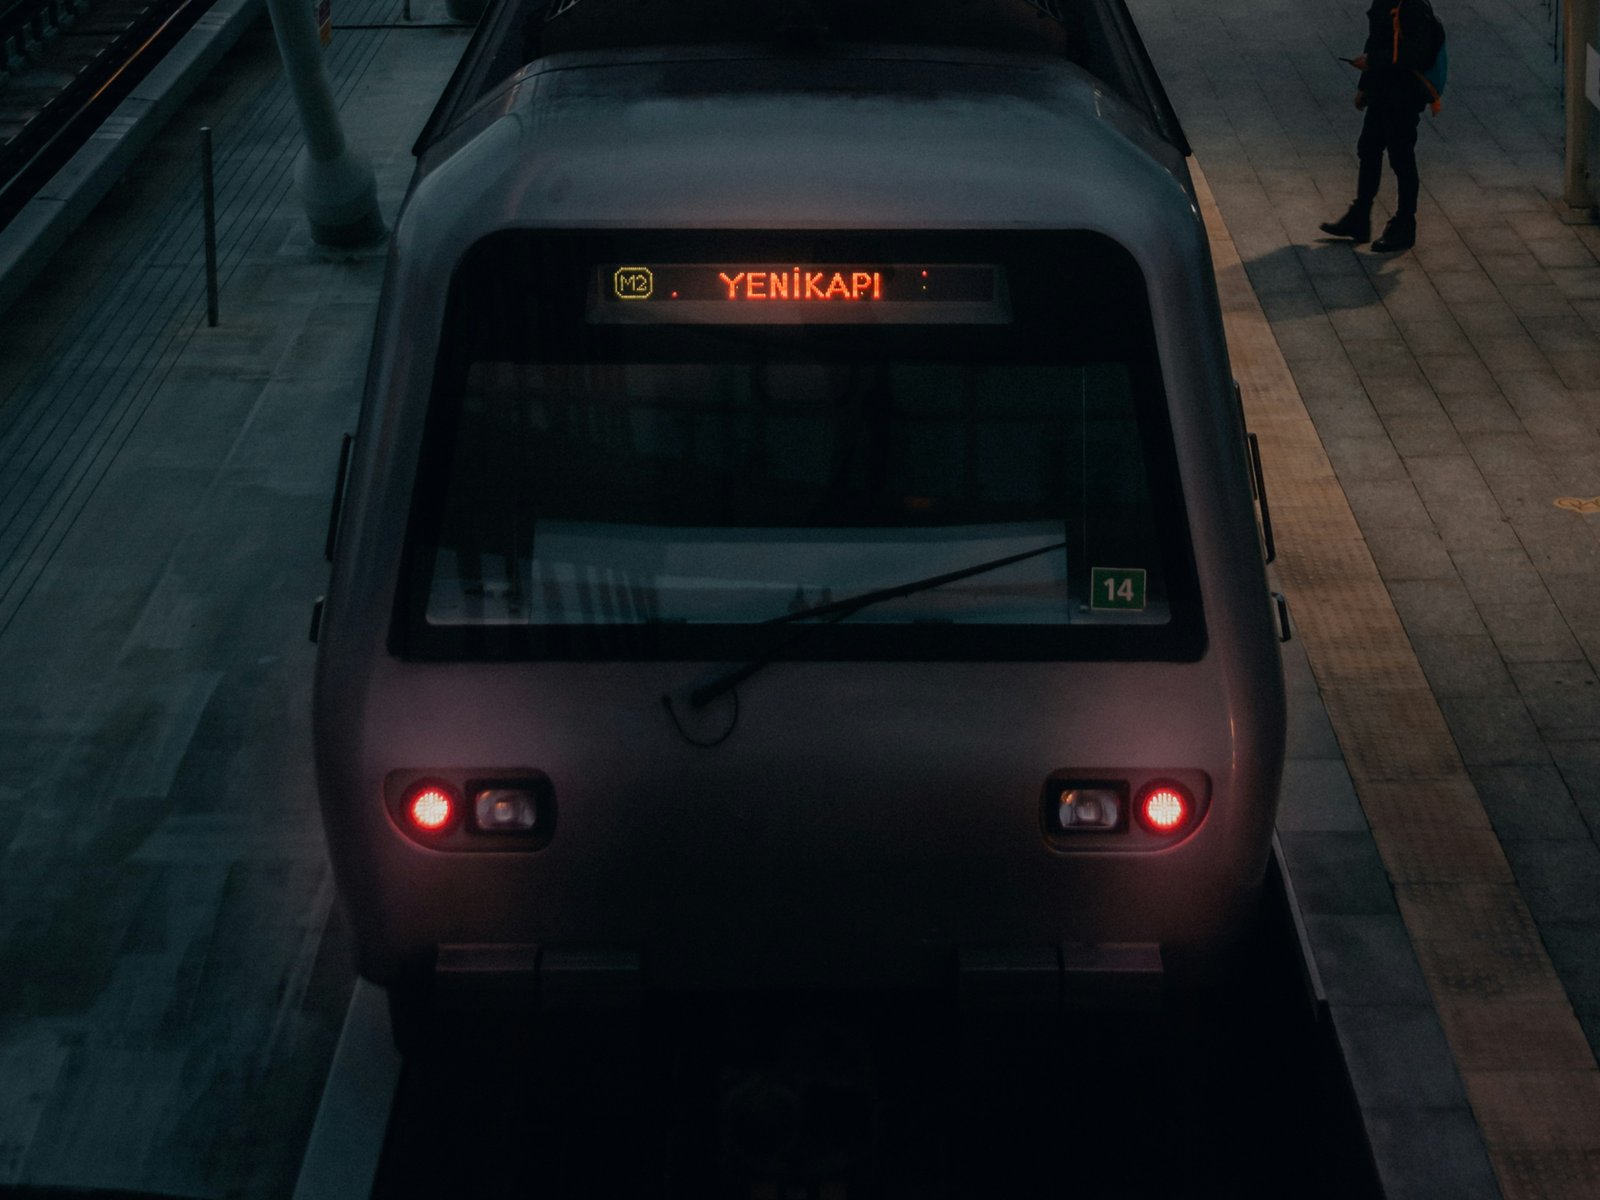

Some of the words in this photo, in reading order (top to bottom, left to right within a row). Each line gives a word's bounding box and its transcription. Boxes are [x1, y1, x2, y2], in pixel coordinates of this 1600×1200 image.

[619, 275, 649, 292] M2
[719, 267, 881, 298] YENİKAPI
[1103, 577, 1134, 602] 14
